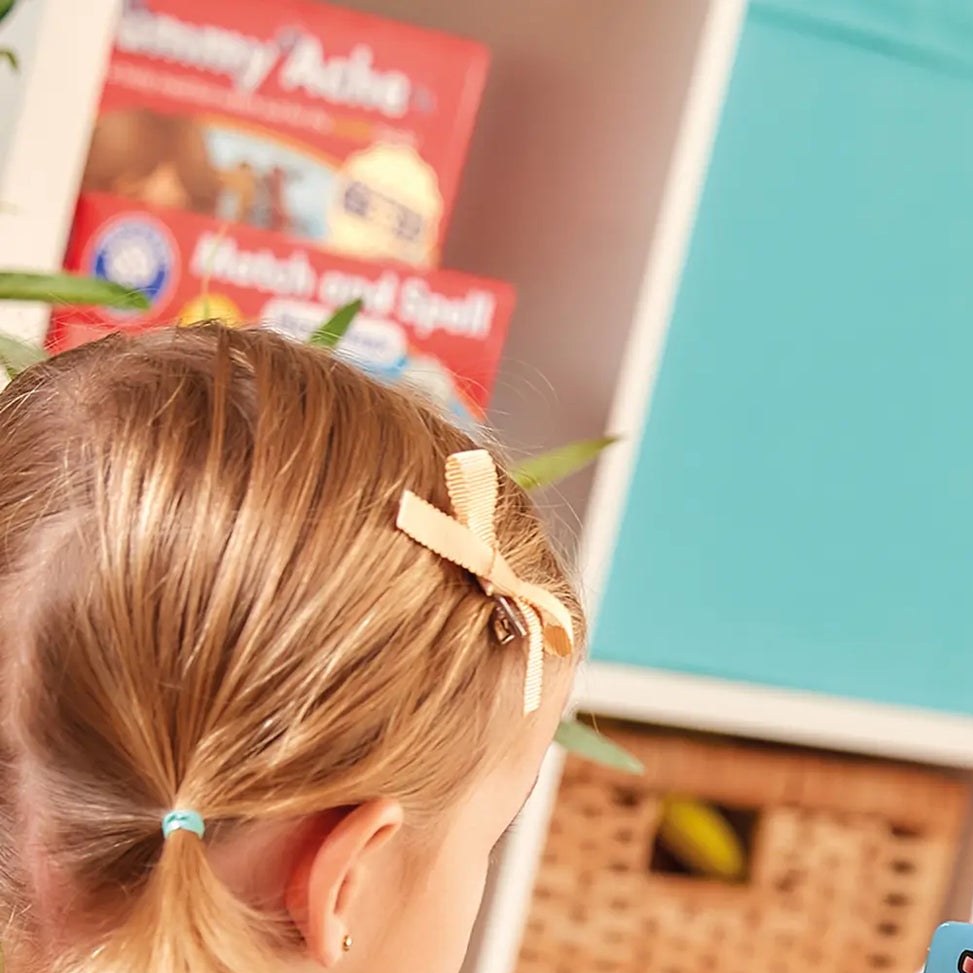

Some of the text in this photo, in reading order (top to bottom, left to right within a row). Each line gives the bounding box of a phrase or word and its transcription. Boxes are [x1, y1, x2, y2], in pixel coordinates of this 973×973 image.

[189, 232, 315, 300] Match
[319, 270, 398, 318] and
[399, 276, 496, 340] Spell
